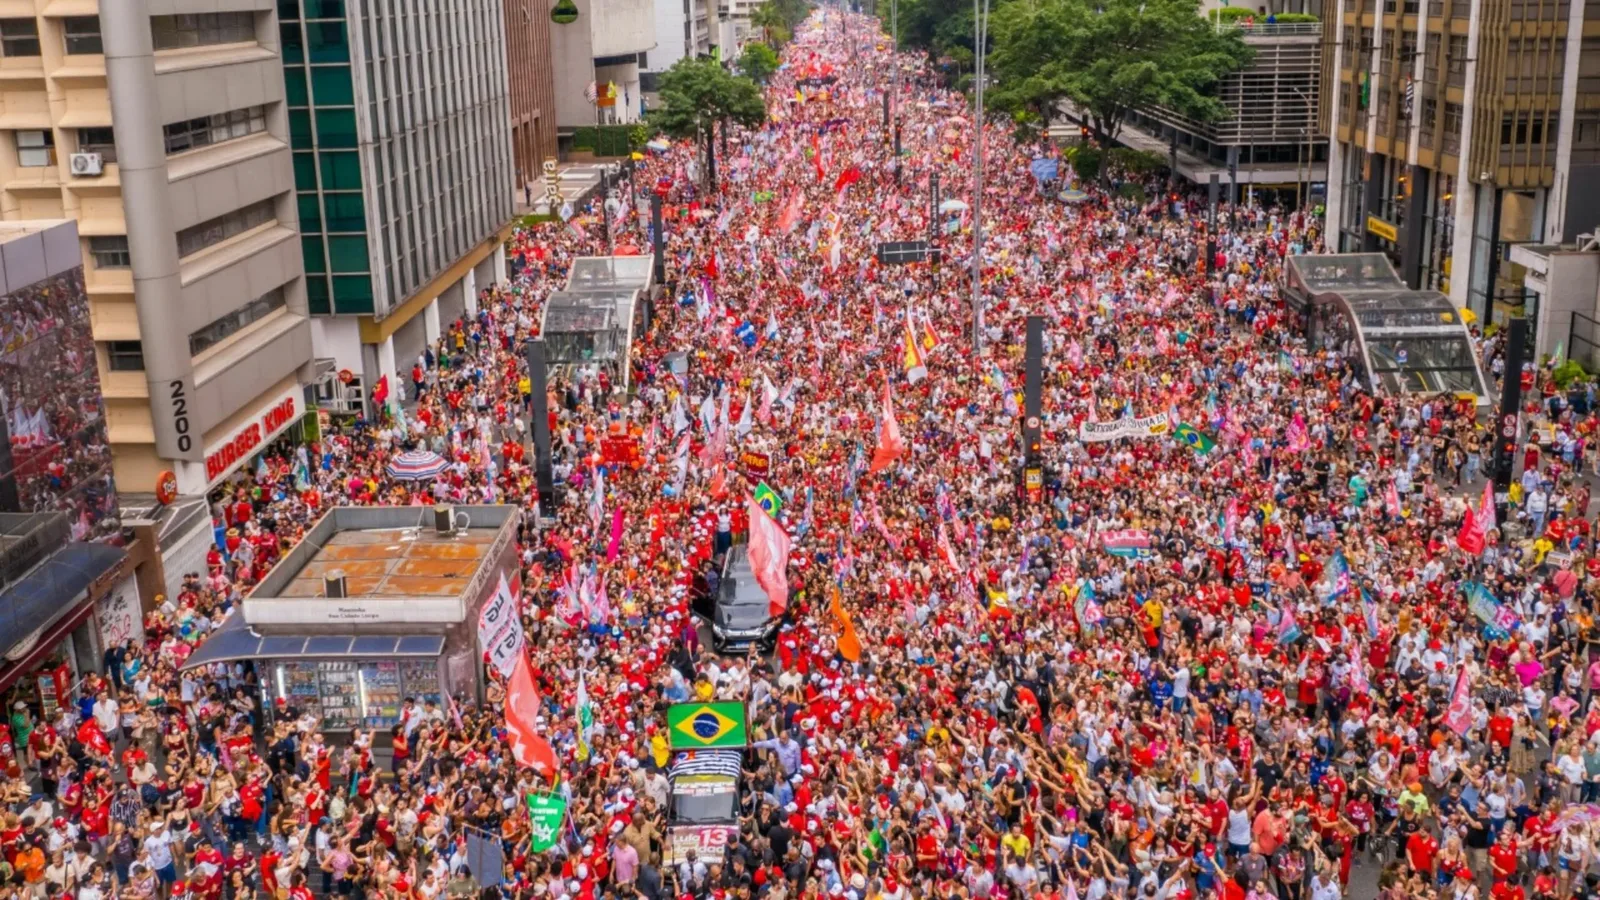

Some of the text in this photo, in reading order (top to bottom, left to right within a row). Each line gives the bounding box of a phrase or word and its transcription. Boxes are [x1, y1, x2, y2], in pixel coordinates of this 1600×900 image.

[170, 380, 192, 452] 2200
[206, 397, 295, 482] BURGER KING
[700, 829, 729, 850] 13
